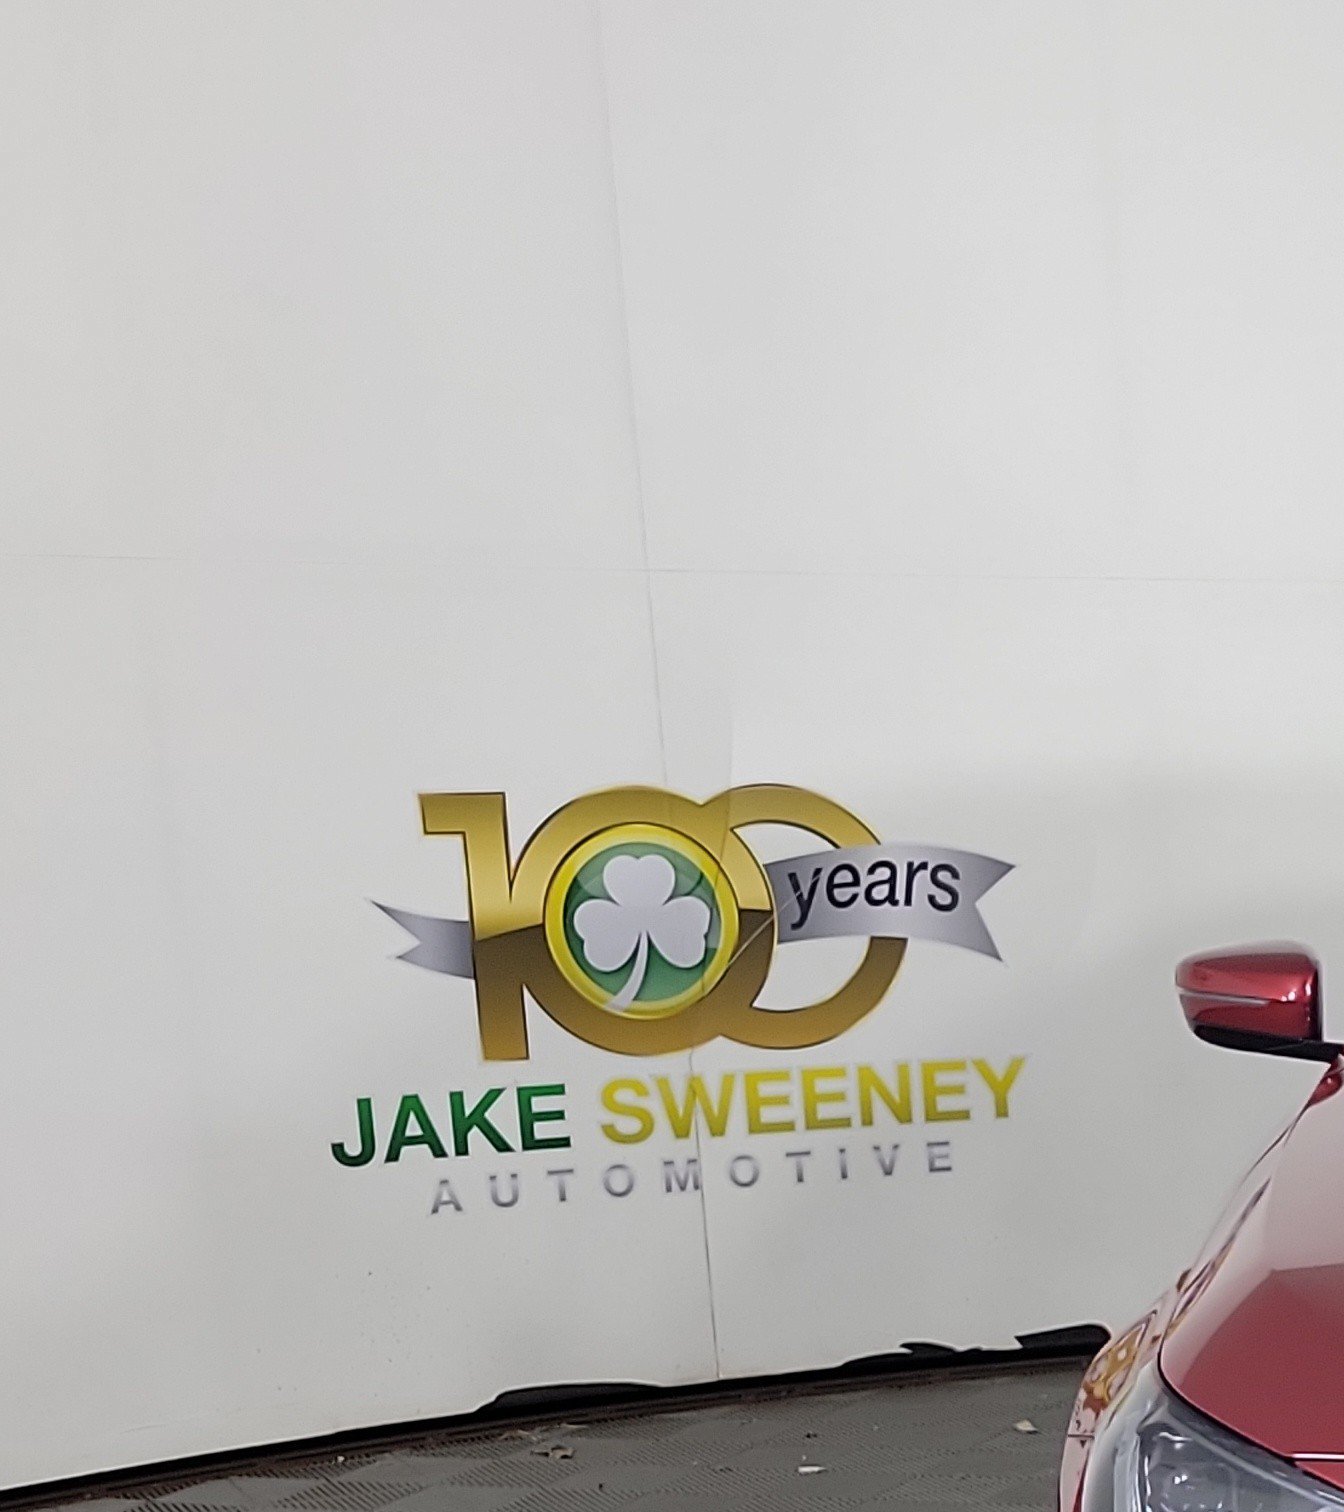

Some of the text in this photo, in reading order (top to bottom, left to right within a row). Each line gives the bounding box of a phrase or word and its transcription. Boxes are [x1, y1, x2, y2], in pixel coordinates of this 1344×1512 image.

[417, 783, 960, 1062] 100 years
[330, 1056, 1028, 1168] JAKE SWEENEY
[430, 1141, 953, 1216] AUTOMOTIVE
